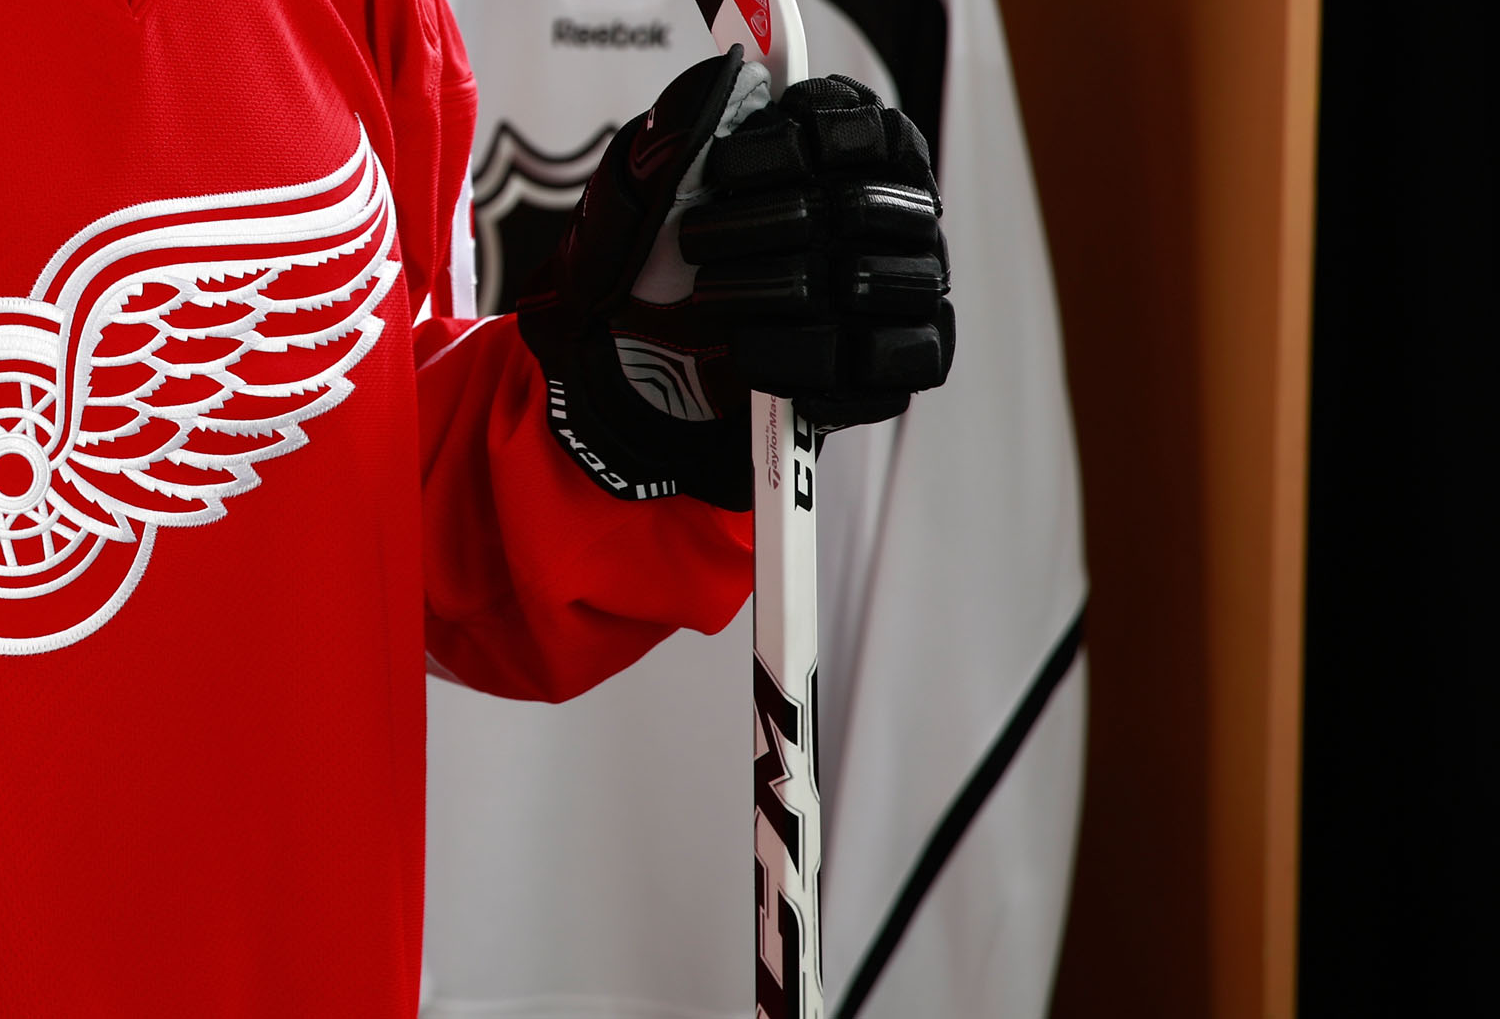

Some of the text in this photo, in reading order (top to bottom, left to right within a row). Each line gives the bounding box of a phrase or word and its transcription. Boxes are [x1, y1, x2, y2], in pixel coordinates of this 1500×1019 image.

[553, 18, 672, 50] Reebok
[558, 429, 628, 491] CCM
[768, 395, 781, 490] TaylorMa
[794, 403, 813, 512] CC
[753, 647, 803, 1019] CM
